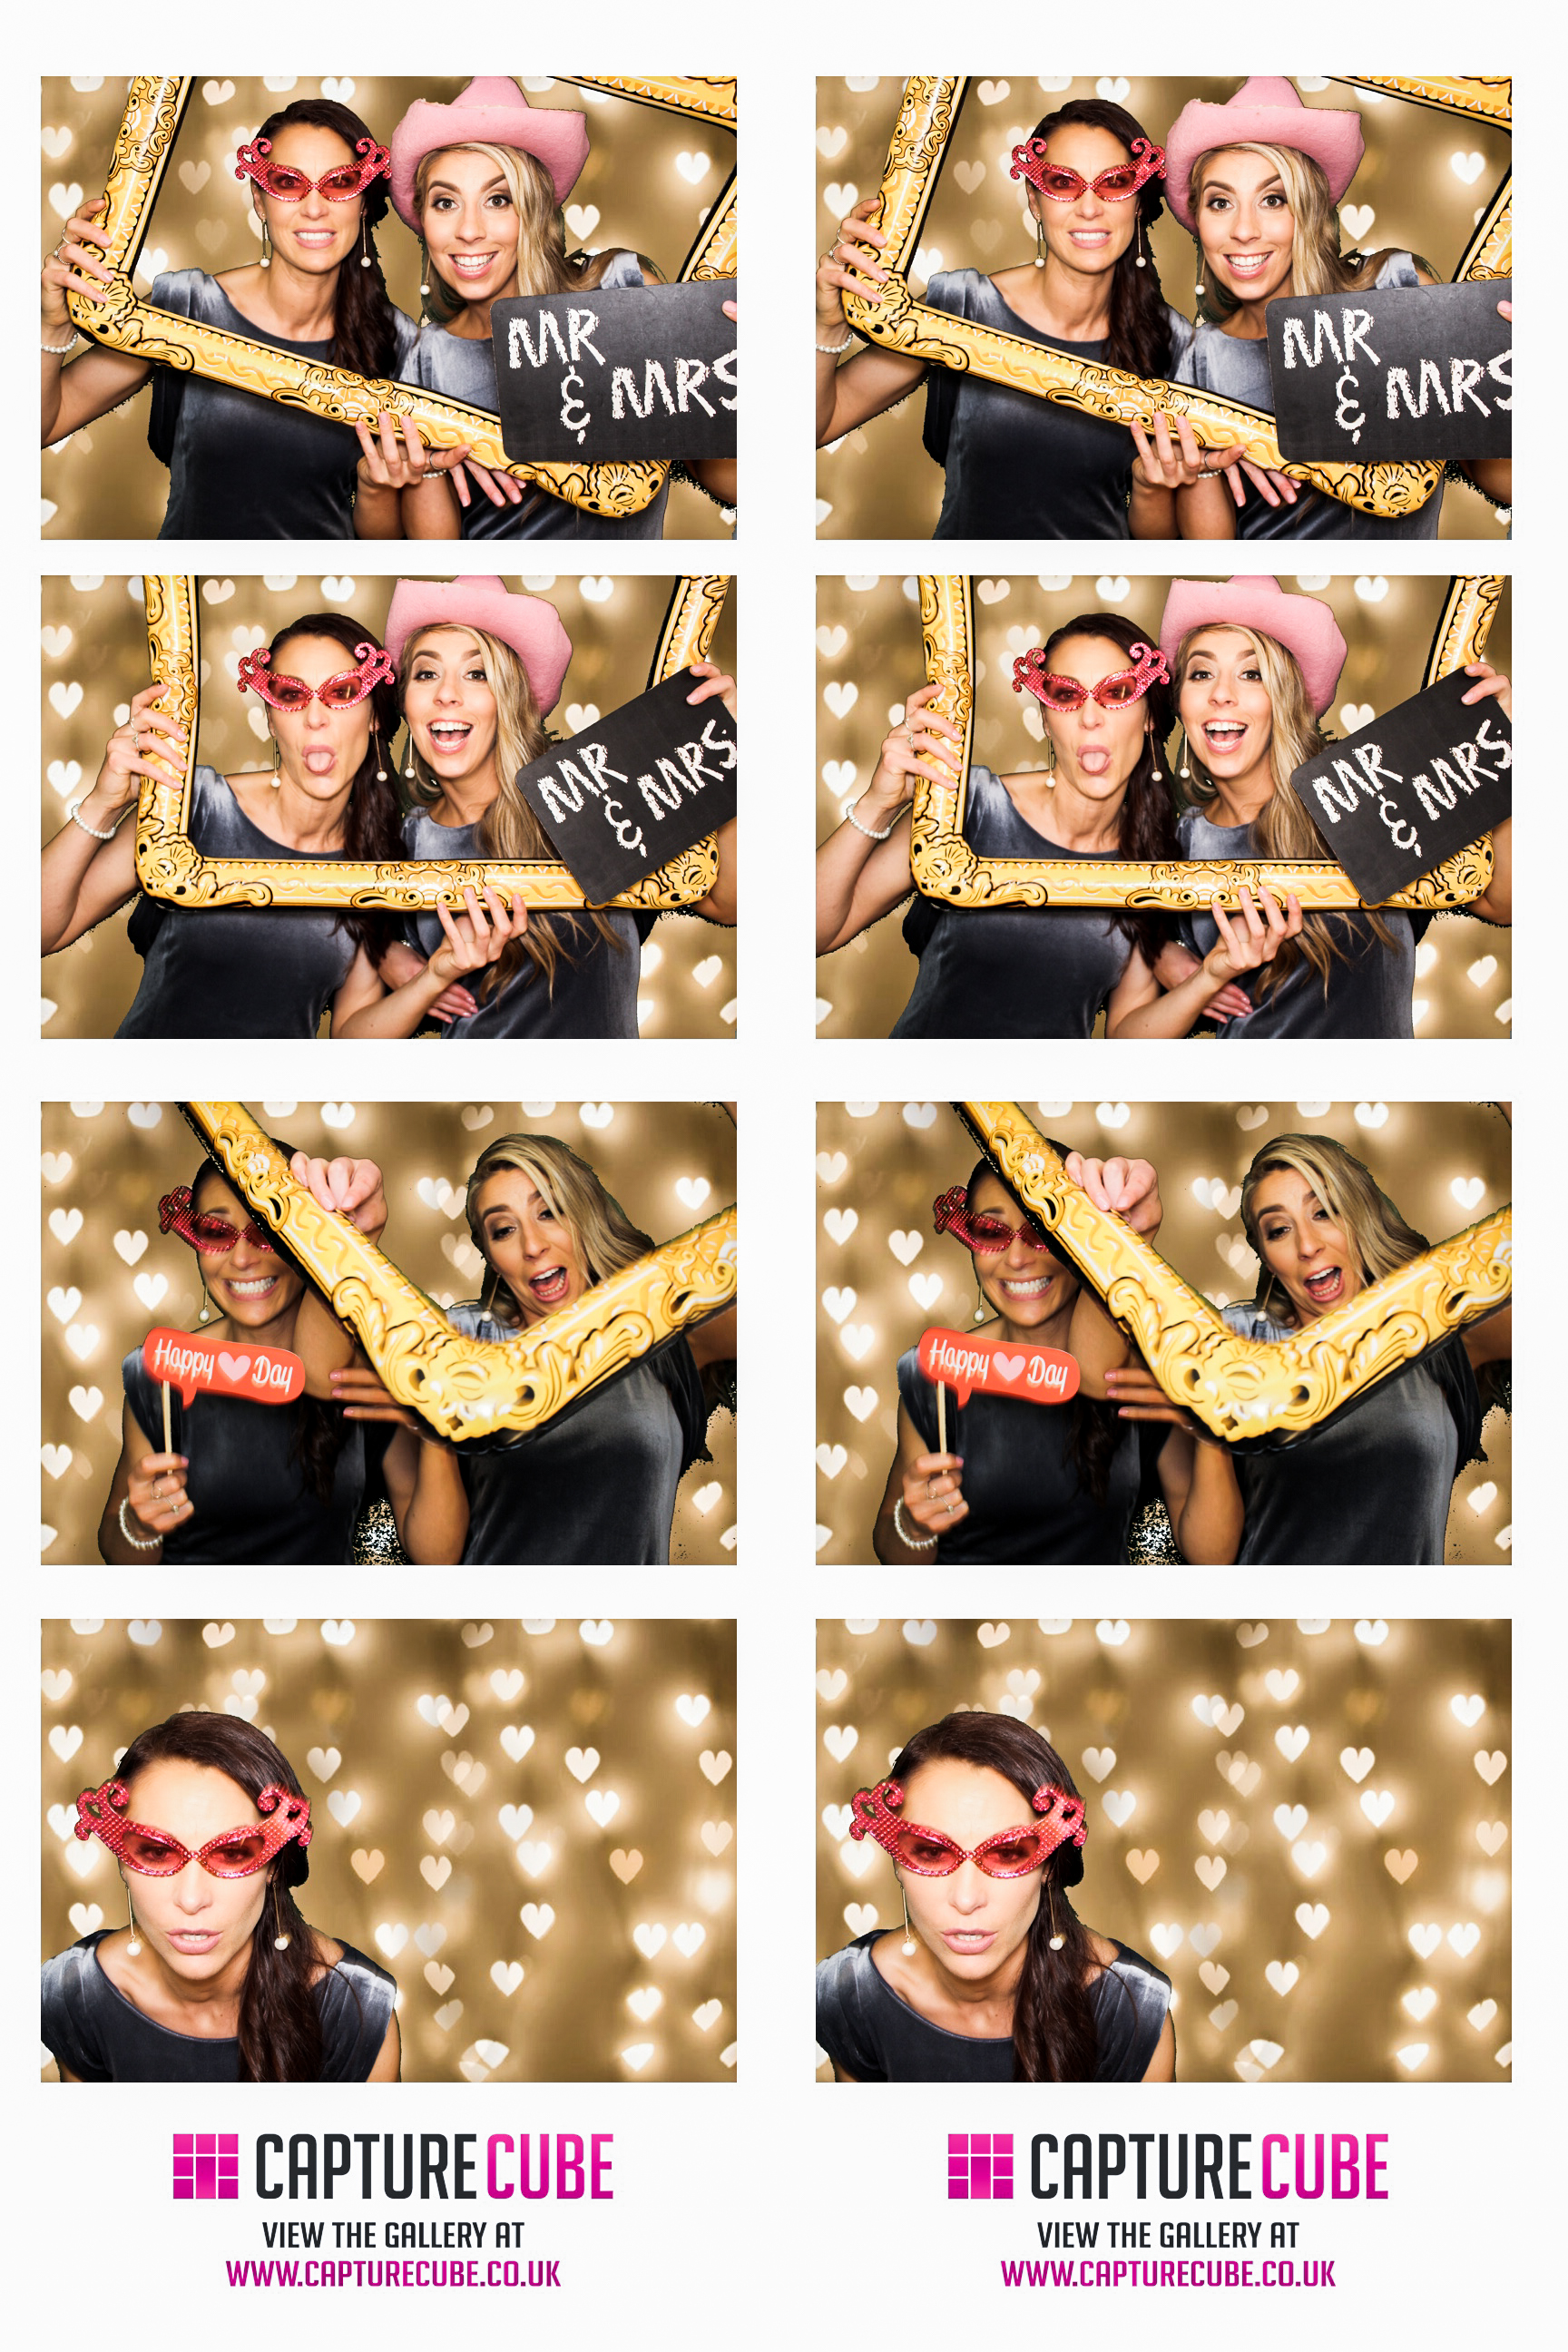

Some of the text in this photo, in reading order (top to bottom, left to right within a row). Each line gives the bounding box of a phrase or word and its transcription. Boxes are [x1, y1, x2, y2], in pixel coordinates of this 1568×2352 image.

[507, 308, 606, 369] MR
[1282, 308, 1381, 369] MR
[559, 348, 737, 445] & MRS
[1334, 348, 1512, 445] & MRS
[537, 742, 628, 823] MR
[603, 719, 737, 858] & MRS
[1312, 742, 1403, 823] MR
[1377, 719, 1512, 858] & MRS
[154, 1338, 293, 1393] Happy Day
[929, 1338, 1068, 1393] Happy Day
